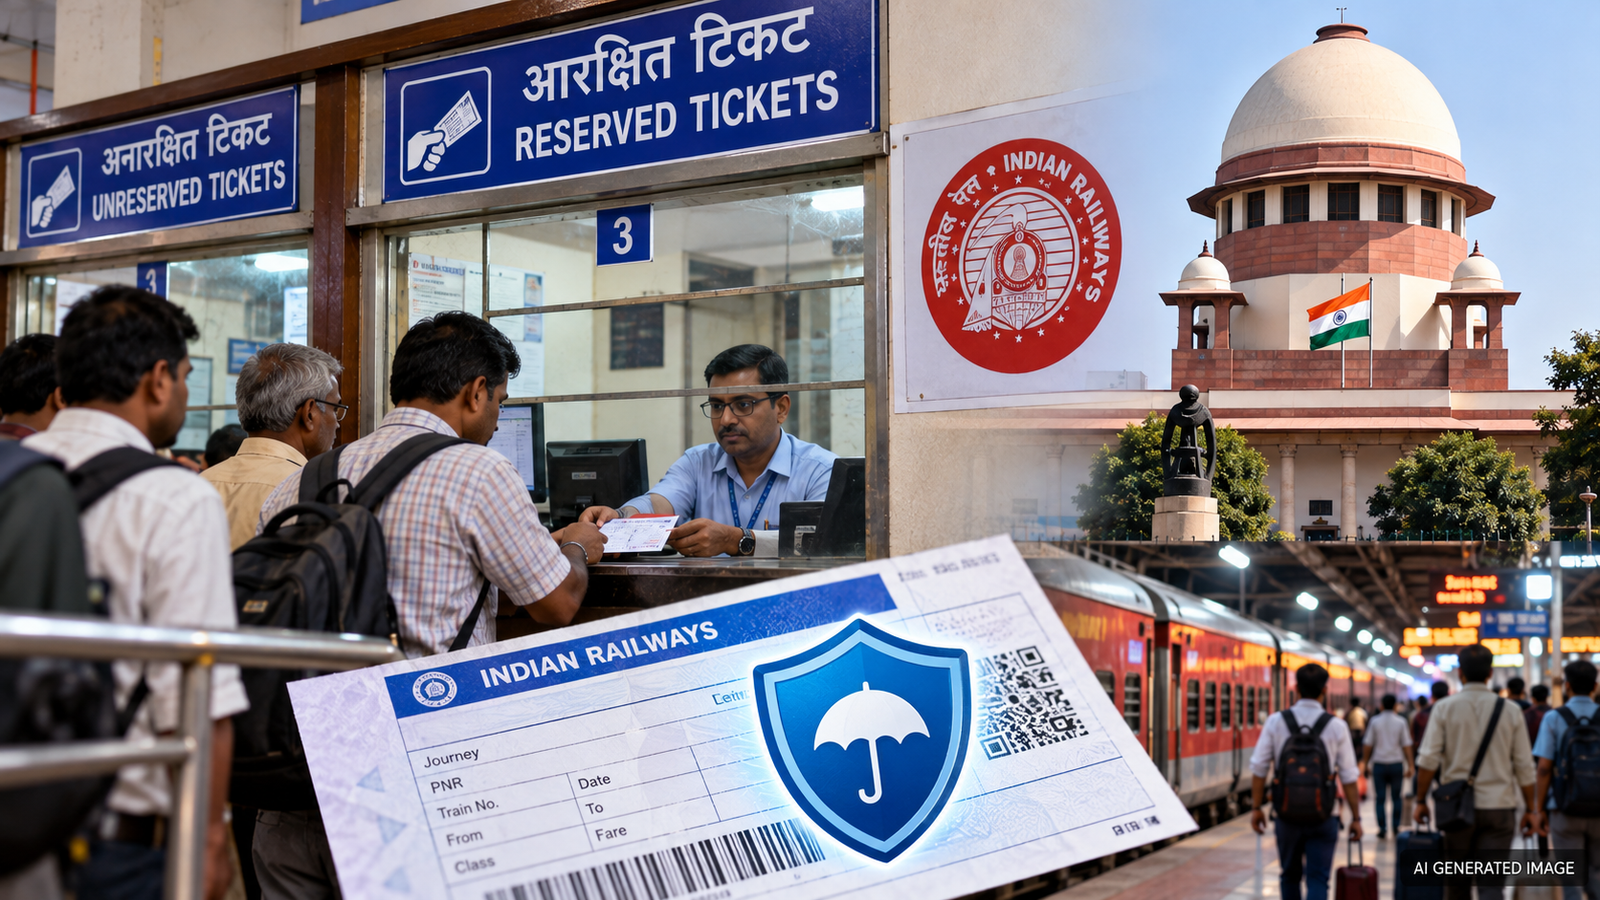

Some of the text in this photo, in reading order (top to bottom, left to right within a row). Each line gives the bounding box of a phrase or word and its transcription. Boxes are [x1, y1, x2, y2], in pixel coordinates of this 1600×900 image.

[522, 6, 814, 102] आरक्षित टिकट
[515, 69, 839, 162] RESERVED TICKETS
[101, 113, 273, 175] अनारक्षित टिकट
[92, 159, 286, 222] UNRESERVED TICKETS
[612, 216, 633, 255] 3
[1003, 150, 1110, 303] INDIAN RAILWAYS
[145, 268, 157, 295] 3
[479, 621, 718, 689] INDIAN RAILWAYS
[424, 747, 480, 769] Journey
[430, 777, 464, 794] PNR
[577, 774, 611, 790] Date
[436, 799, 499, 819] Train No.
[585, 802, 604, 815] To
[446, 831, 483, 846] From
[595, 825, 627, 842] Fare
[455, 855, 495, 875] Class
